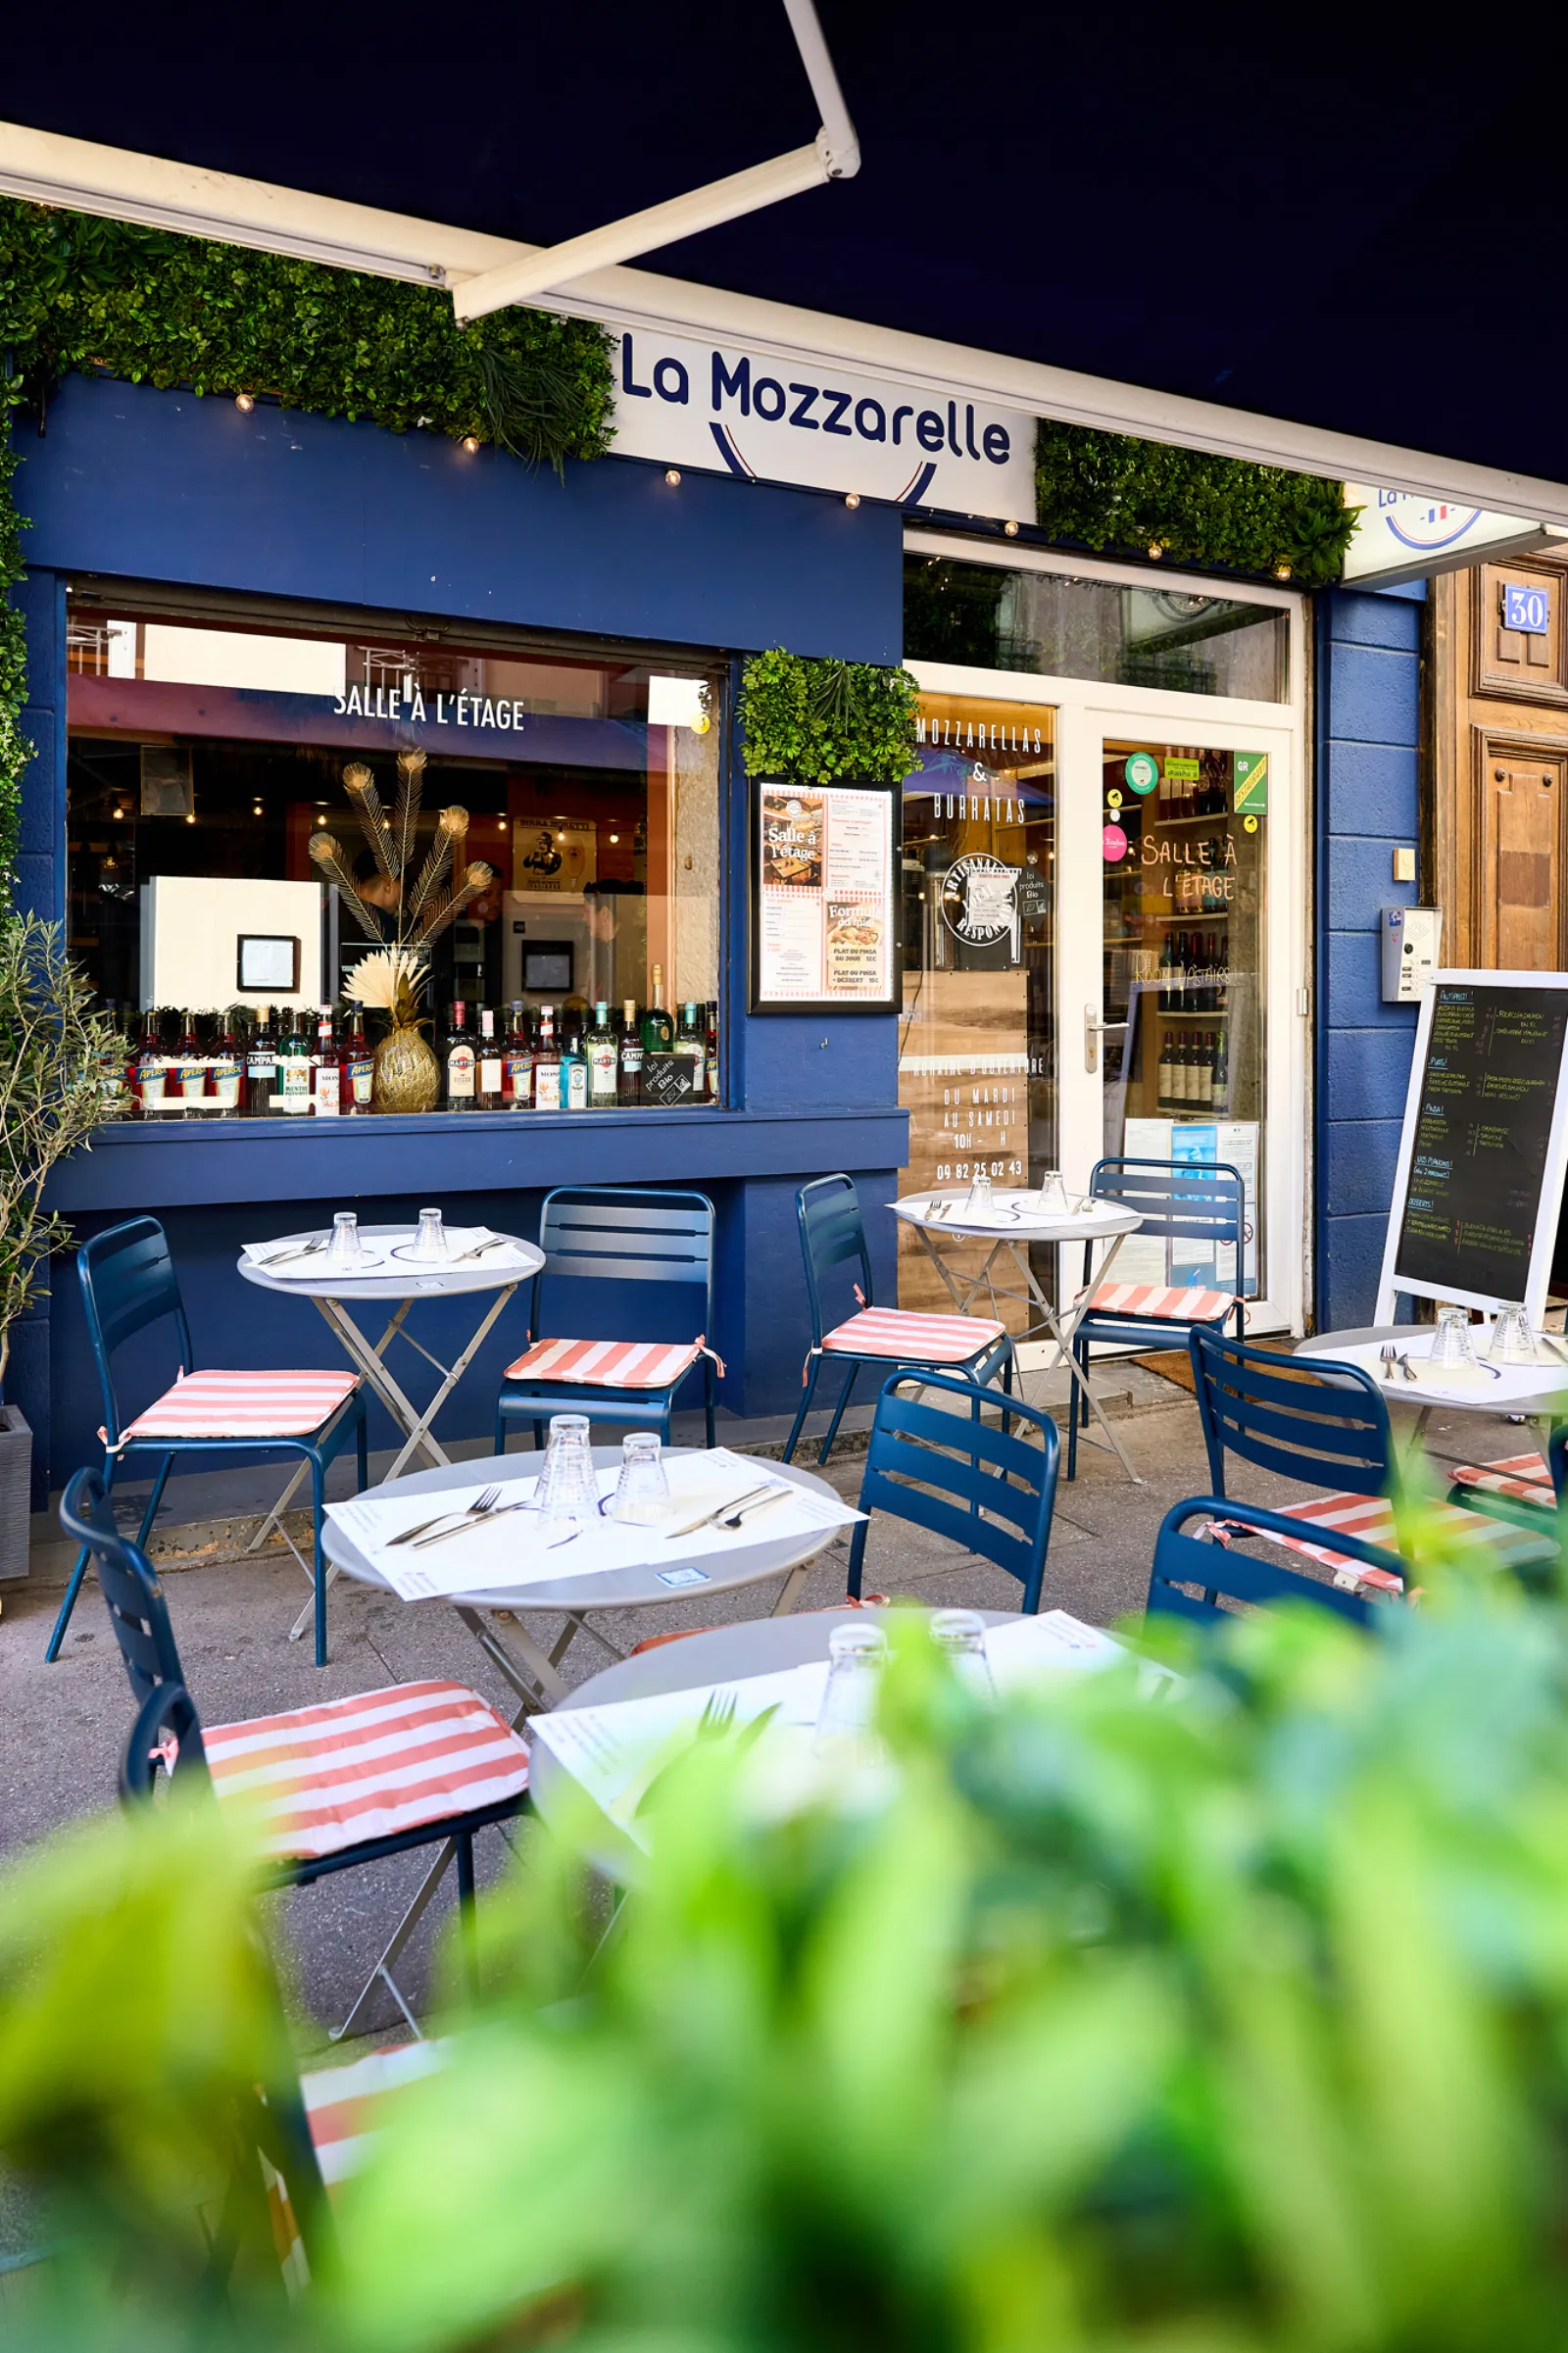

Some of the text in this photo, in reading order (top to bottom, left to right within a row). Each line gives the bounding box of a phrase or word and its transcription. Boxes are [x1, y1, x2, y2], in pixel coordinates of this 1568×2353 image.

[622, 332, 1010, 466] La Mozzarelle
[1511, 591, 1543, 628] 30
[333, 682, 524, 731] SALLE À L'ÉTAGE
[915, 716, 1042, 755] MOZZARELLAS
[972, 761, 987, 783] &
[1238, 760, 1249, 772] GR
[933, 792, 1026, 824] BURRATAS
[768, 826, 816, 845] Salle à
[771, 842, 815, 862] l'étage
[1141, 833, 1238, 865] SALLE À
[1019, 881, 1044, 892] produits
[1163, 868, 1236, 900] L'ÉTAGE
[646, 1059, 675, 1092] produits
[647, 1061, 659, 1073] Ici
[658, 1074, 674, 1090] Bio
[944, 1087, 1015, 1105] DU MARDI
[944, 1109, 1015, 1129] AU SAMEDI
[954, 1133, 972, 1150] 10H
[937, 1160, 1022, 1181] 09 82 25 02 43
